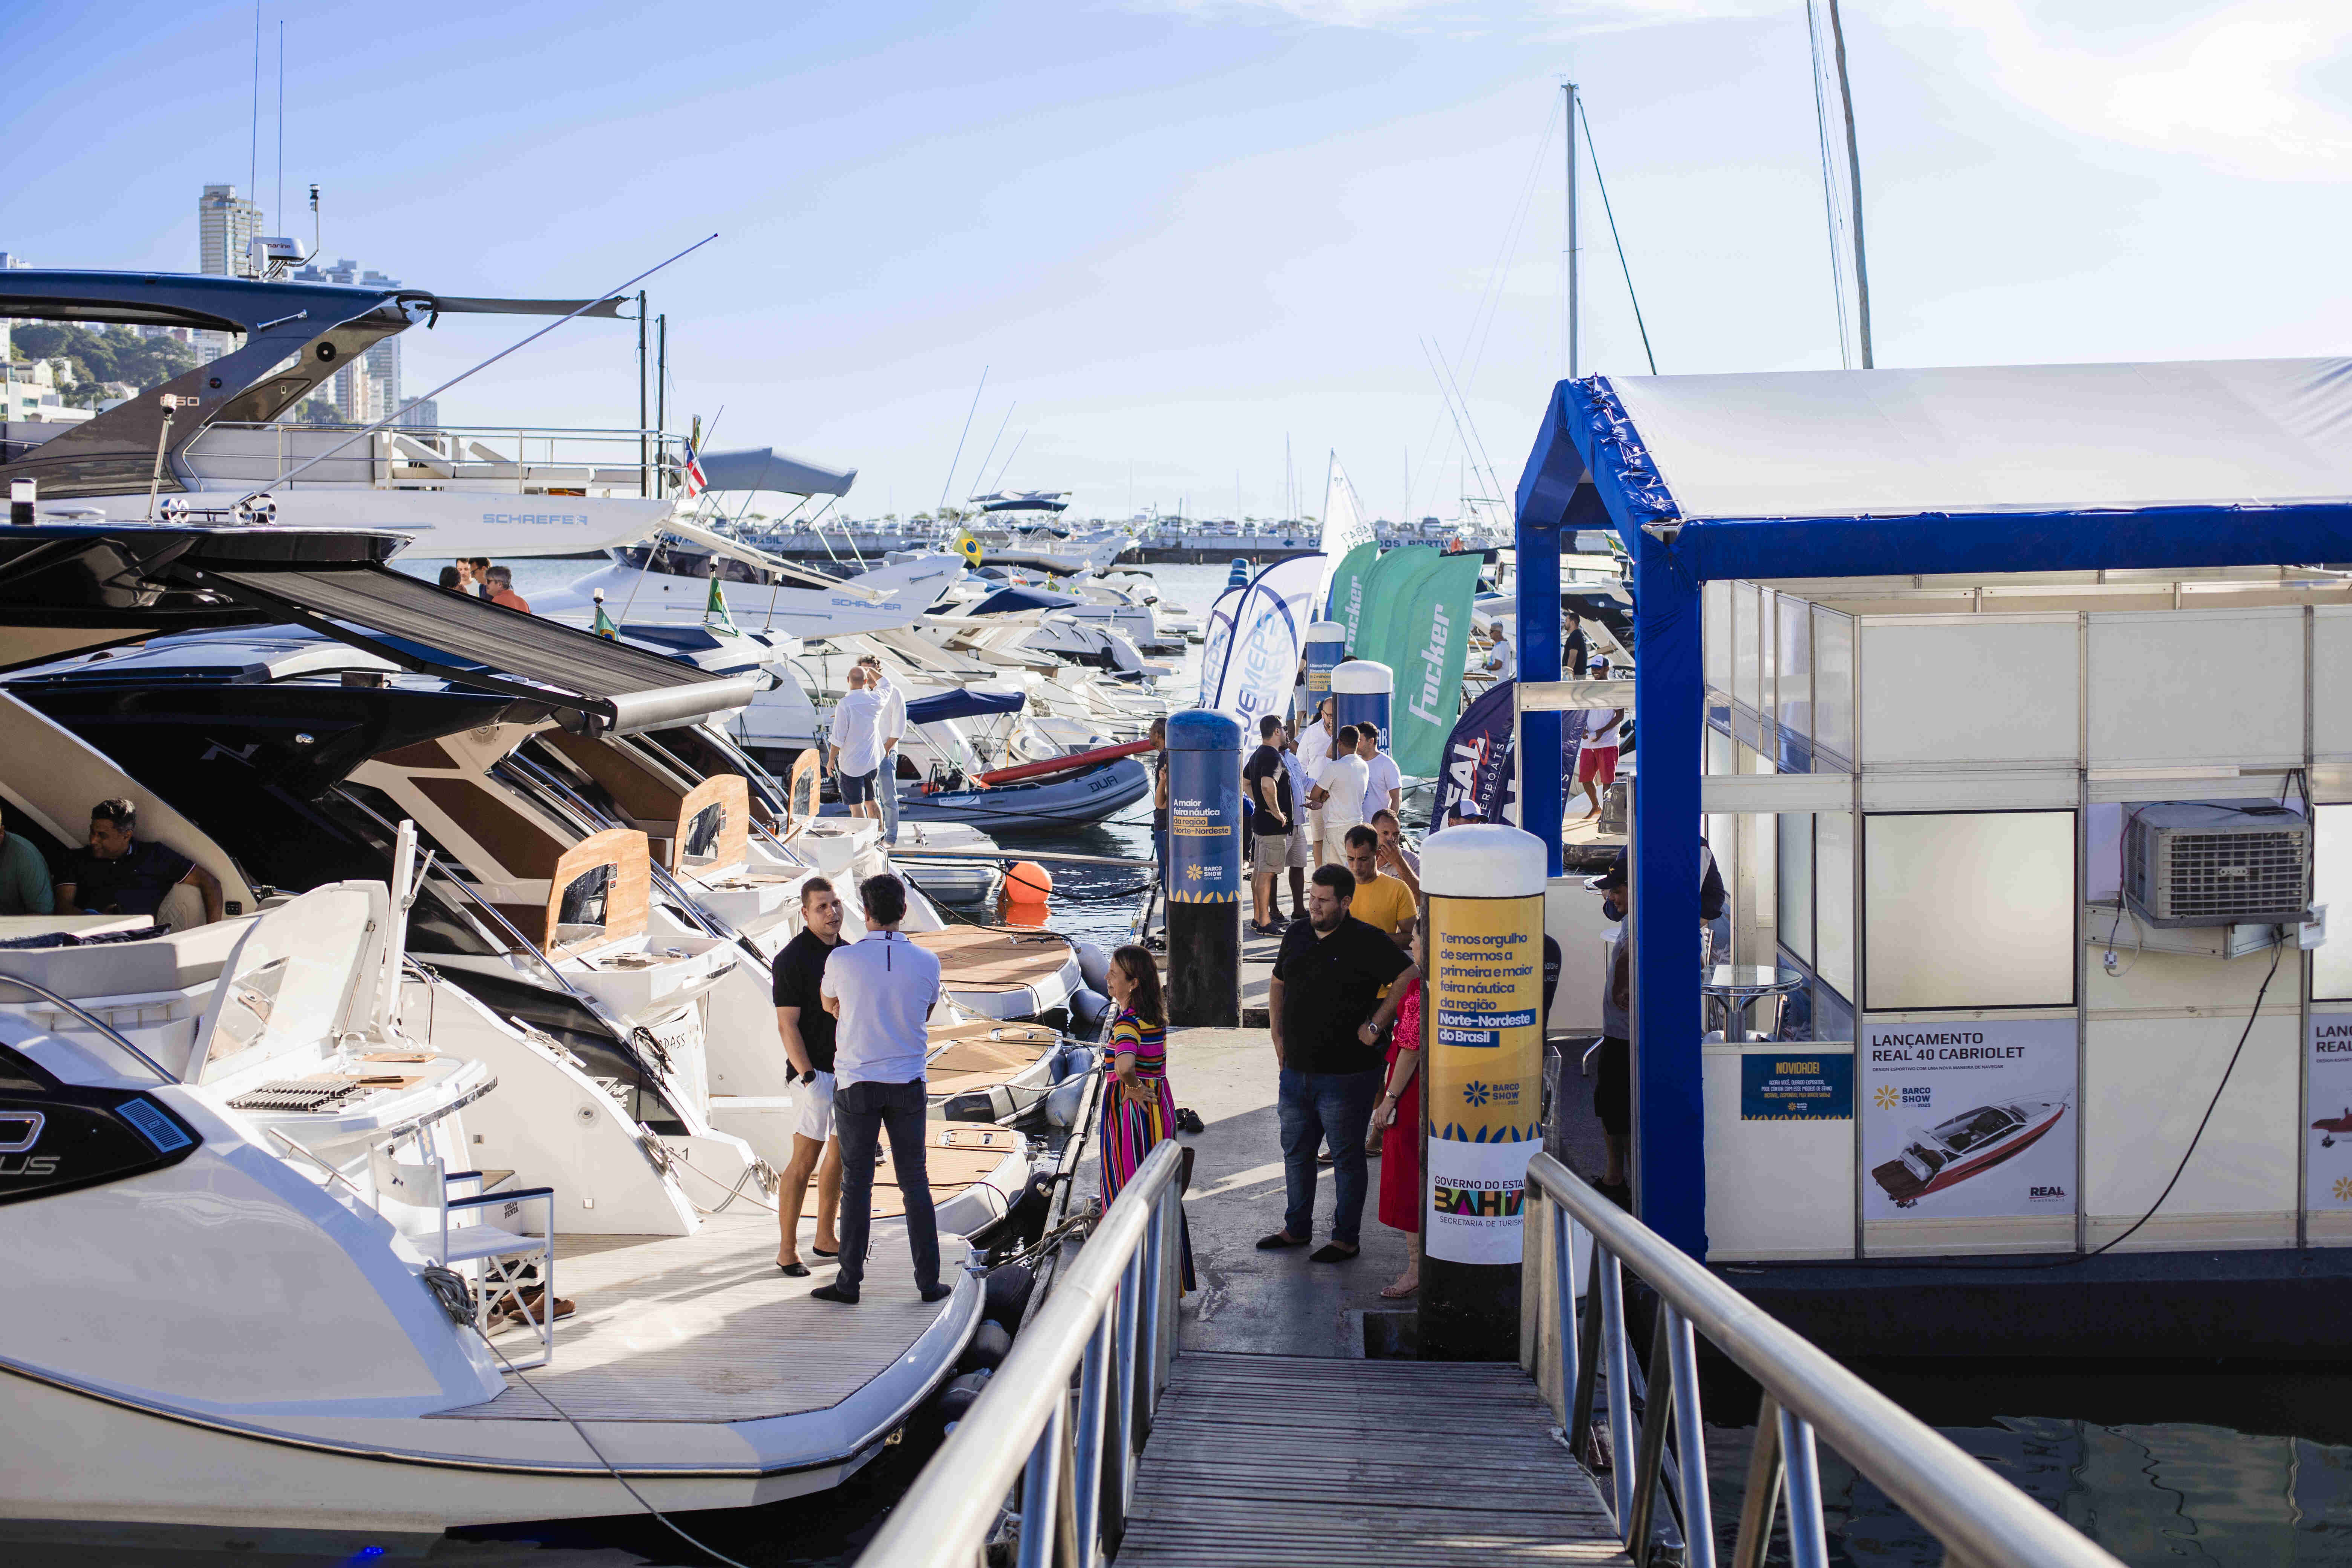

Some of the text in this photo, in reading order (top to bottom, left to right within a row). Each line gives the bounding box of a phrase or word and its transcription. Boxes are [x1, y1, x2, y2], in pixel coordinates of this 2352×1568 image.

[482, 514, 588, 525] SCHAEFER
[1377, 728, 1387, 747] AR
[1479, 743, 1505, 810] ERBOATS
[1182, 818, 1206, 826] região
[1441, 932, 1527, 948] Temos orgulho
[1441, 949, 1513, 961] de sermos a
[1441, 964, 1533, 978] primeira e maior
[1441, 980, 1514, 994] feira náutica
[1441, 997, 1496, 1013] da região
[1440, 1029, 1490, 1043] do Brasil
[2317, 1026, 2352, 1037] LAN
[1872, 1032, 1983, 1049] LANÇAMENTO
[1873, 1047, 2025, 1061] REAL 40 CABRIOLET
[1776, 1062, 1820, 1074] NOVIDADE!
[1492, 1091, 1520, 1100] SHOW
[1435, 1176, 1481, 1189] GOVERNO
[1485, 1181, 1499, 1189] DO
[2030, 1186, 2064, 1196] REAL
[1439, 1216, 1483, 1227] SECRETARIA
